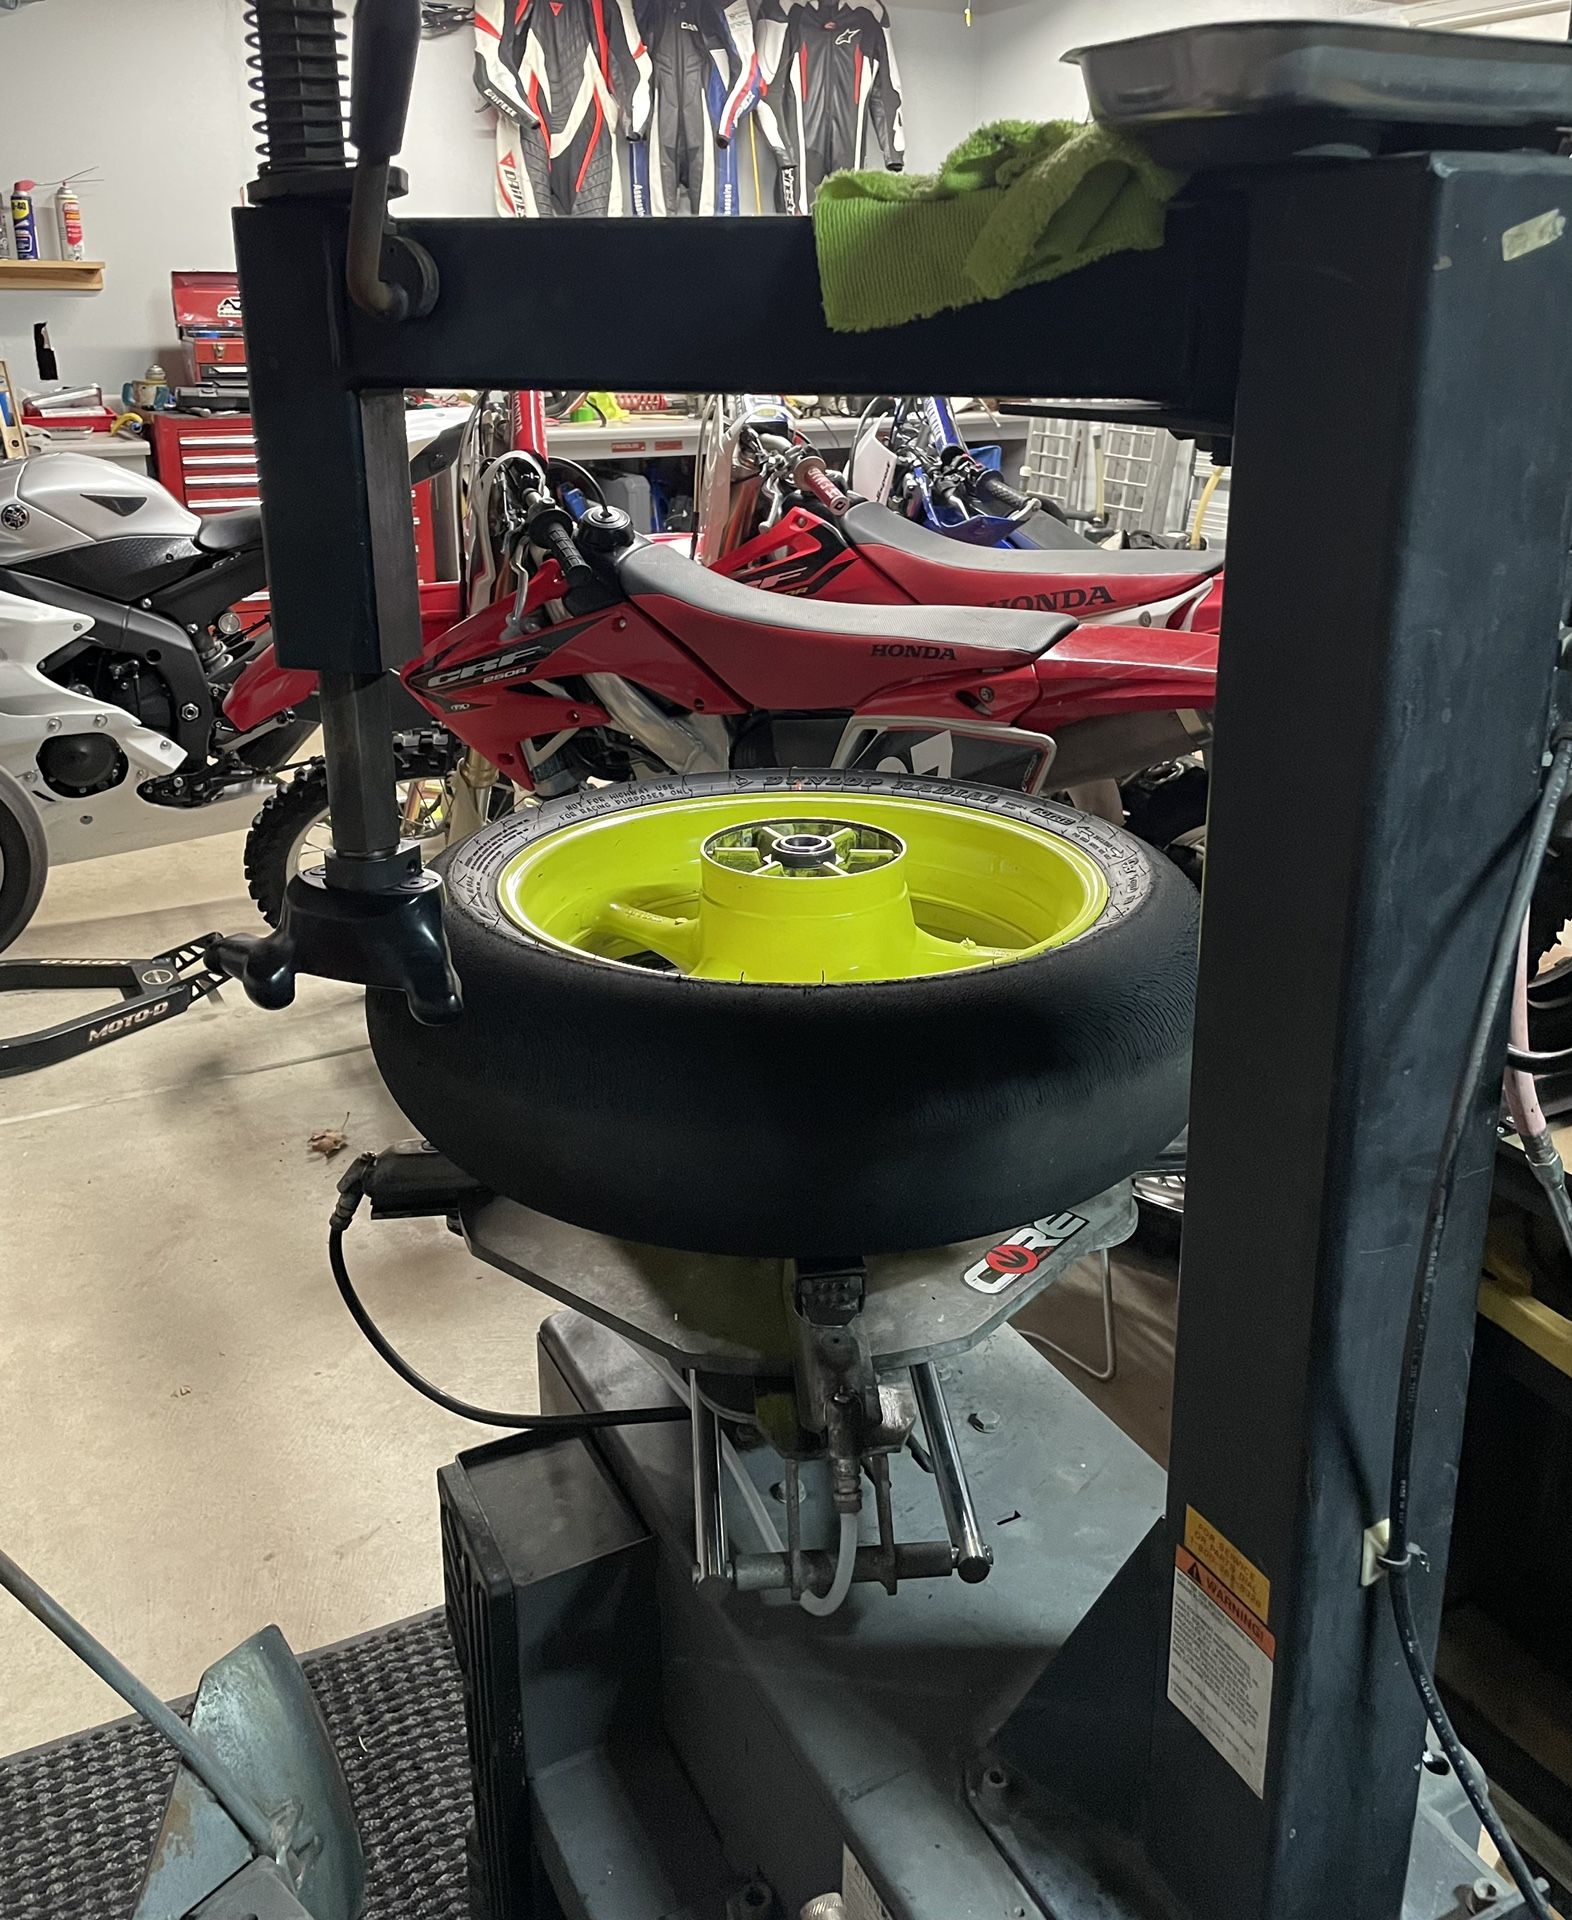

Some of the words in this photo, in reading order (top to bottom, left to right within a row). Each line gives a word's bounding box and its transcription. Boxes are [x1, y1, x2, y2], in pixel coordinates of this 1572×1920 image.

[985, 585, 1117, 611] ONDA
[427, 646, 541, 687] CRF
[870, 644, 956, 661] HONDA
[482, 667, 527, 683] 250R
[565, 802, 583, 812] NOT
[587, 796, 605, 805] FOR
[608, 787, 648, 801] HIGHWAY
[655, 783, 675, 791] USE
[763, 775, 883, 787] DUNLOP
[891, 779, 999, 804] RADIAL
[559, 811, 577, 821] FOR
[580, 802, 611, 815] RACING
[616, 791, 664, 806] PURPOSES
[89, 1001, 169, 1042] MOTO-D
[1198, 1522, 1215, 1543] FOR
[1219, 1541, 1255, 1581] SERVICE
[1209, 1543, 1236, 1574] PARTS
[1238, 1571, 1256, 1593] DIAL
[1206, 1577, 1264, 1639] WARNING!
